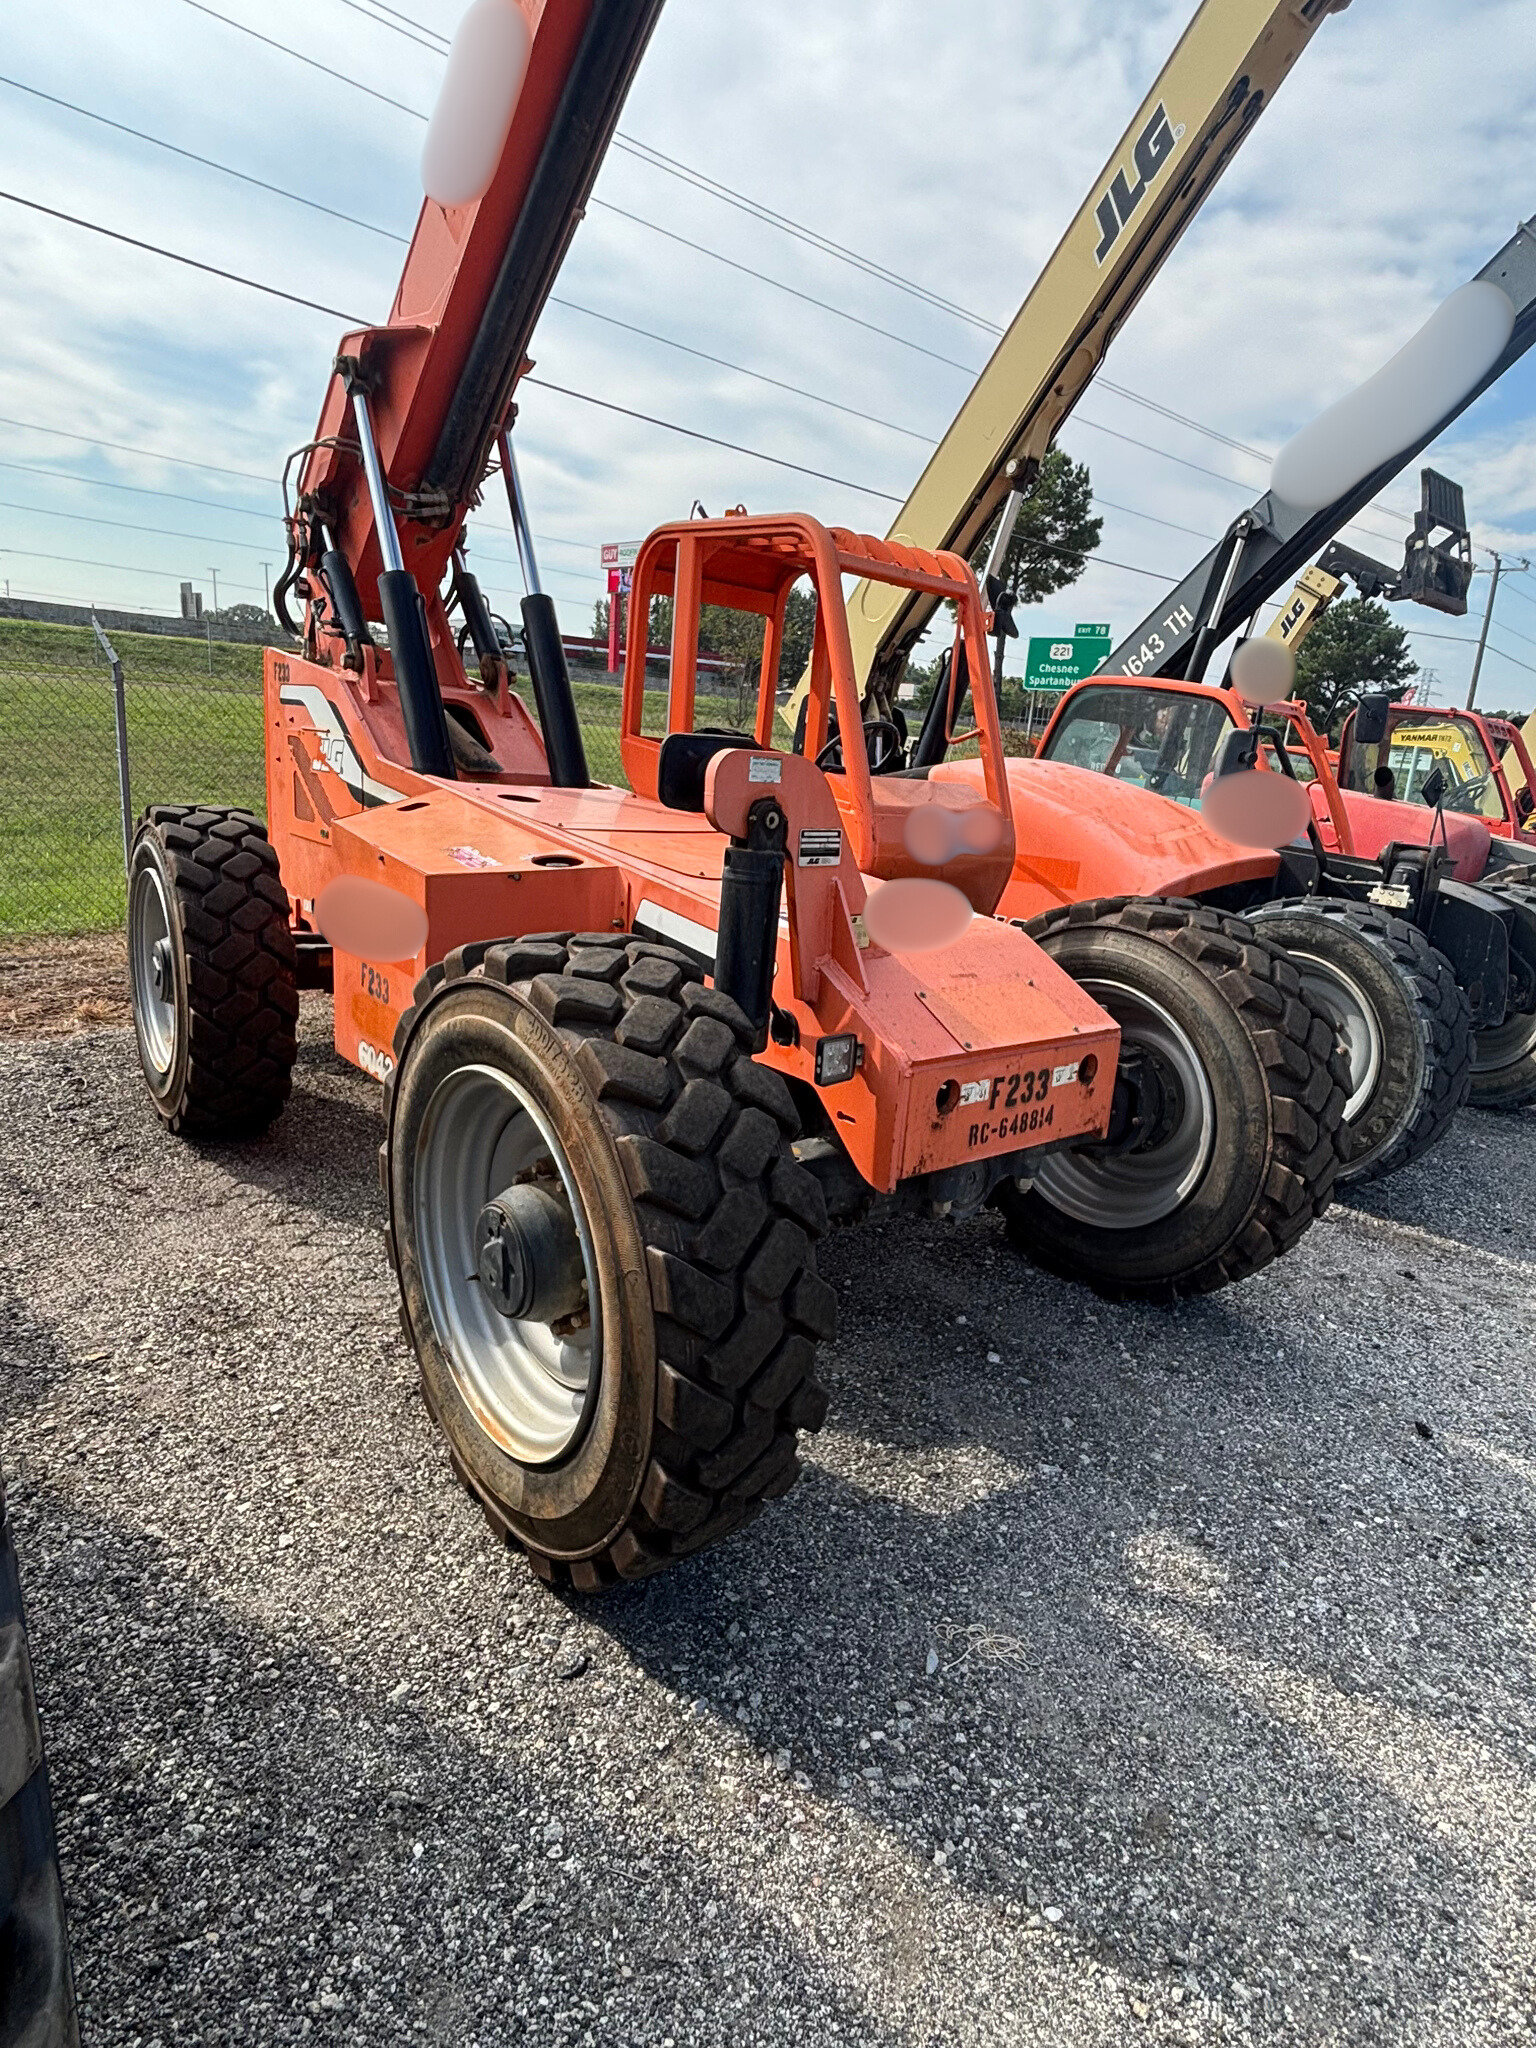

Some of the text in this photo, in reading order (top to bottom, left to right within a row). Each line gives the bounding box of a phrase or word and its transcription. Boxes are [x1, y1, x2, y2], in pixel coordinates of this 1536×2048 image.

[603, 549, 617, 560] GUY
[1163, 604, 1194, 636] TH
[1279, 598, 1306, 639] JLG
[1095, 626, 1107, 635] 78
[1053, 647, 1070, 657] 221
[1039, 663, 1080, 674] Chesnee
[1401, 734, 1438, 742] YANMAR
[361, 962, 390, 1005] F233
[358, 1040, 394, 1084] 6042
[988, 1068, 1051, 1111] F233
